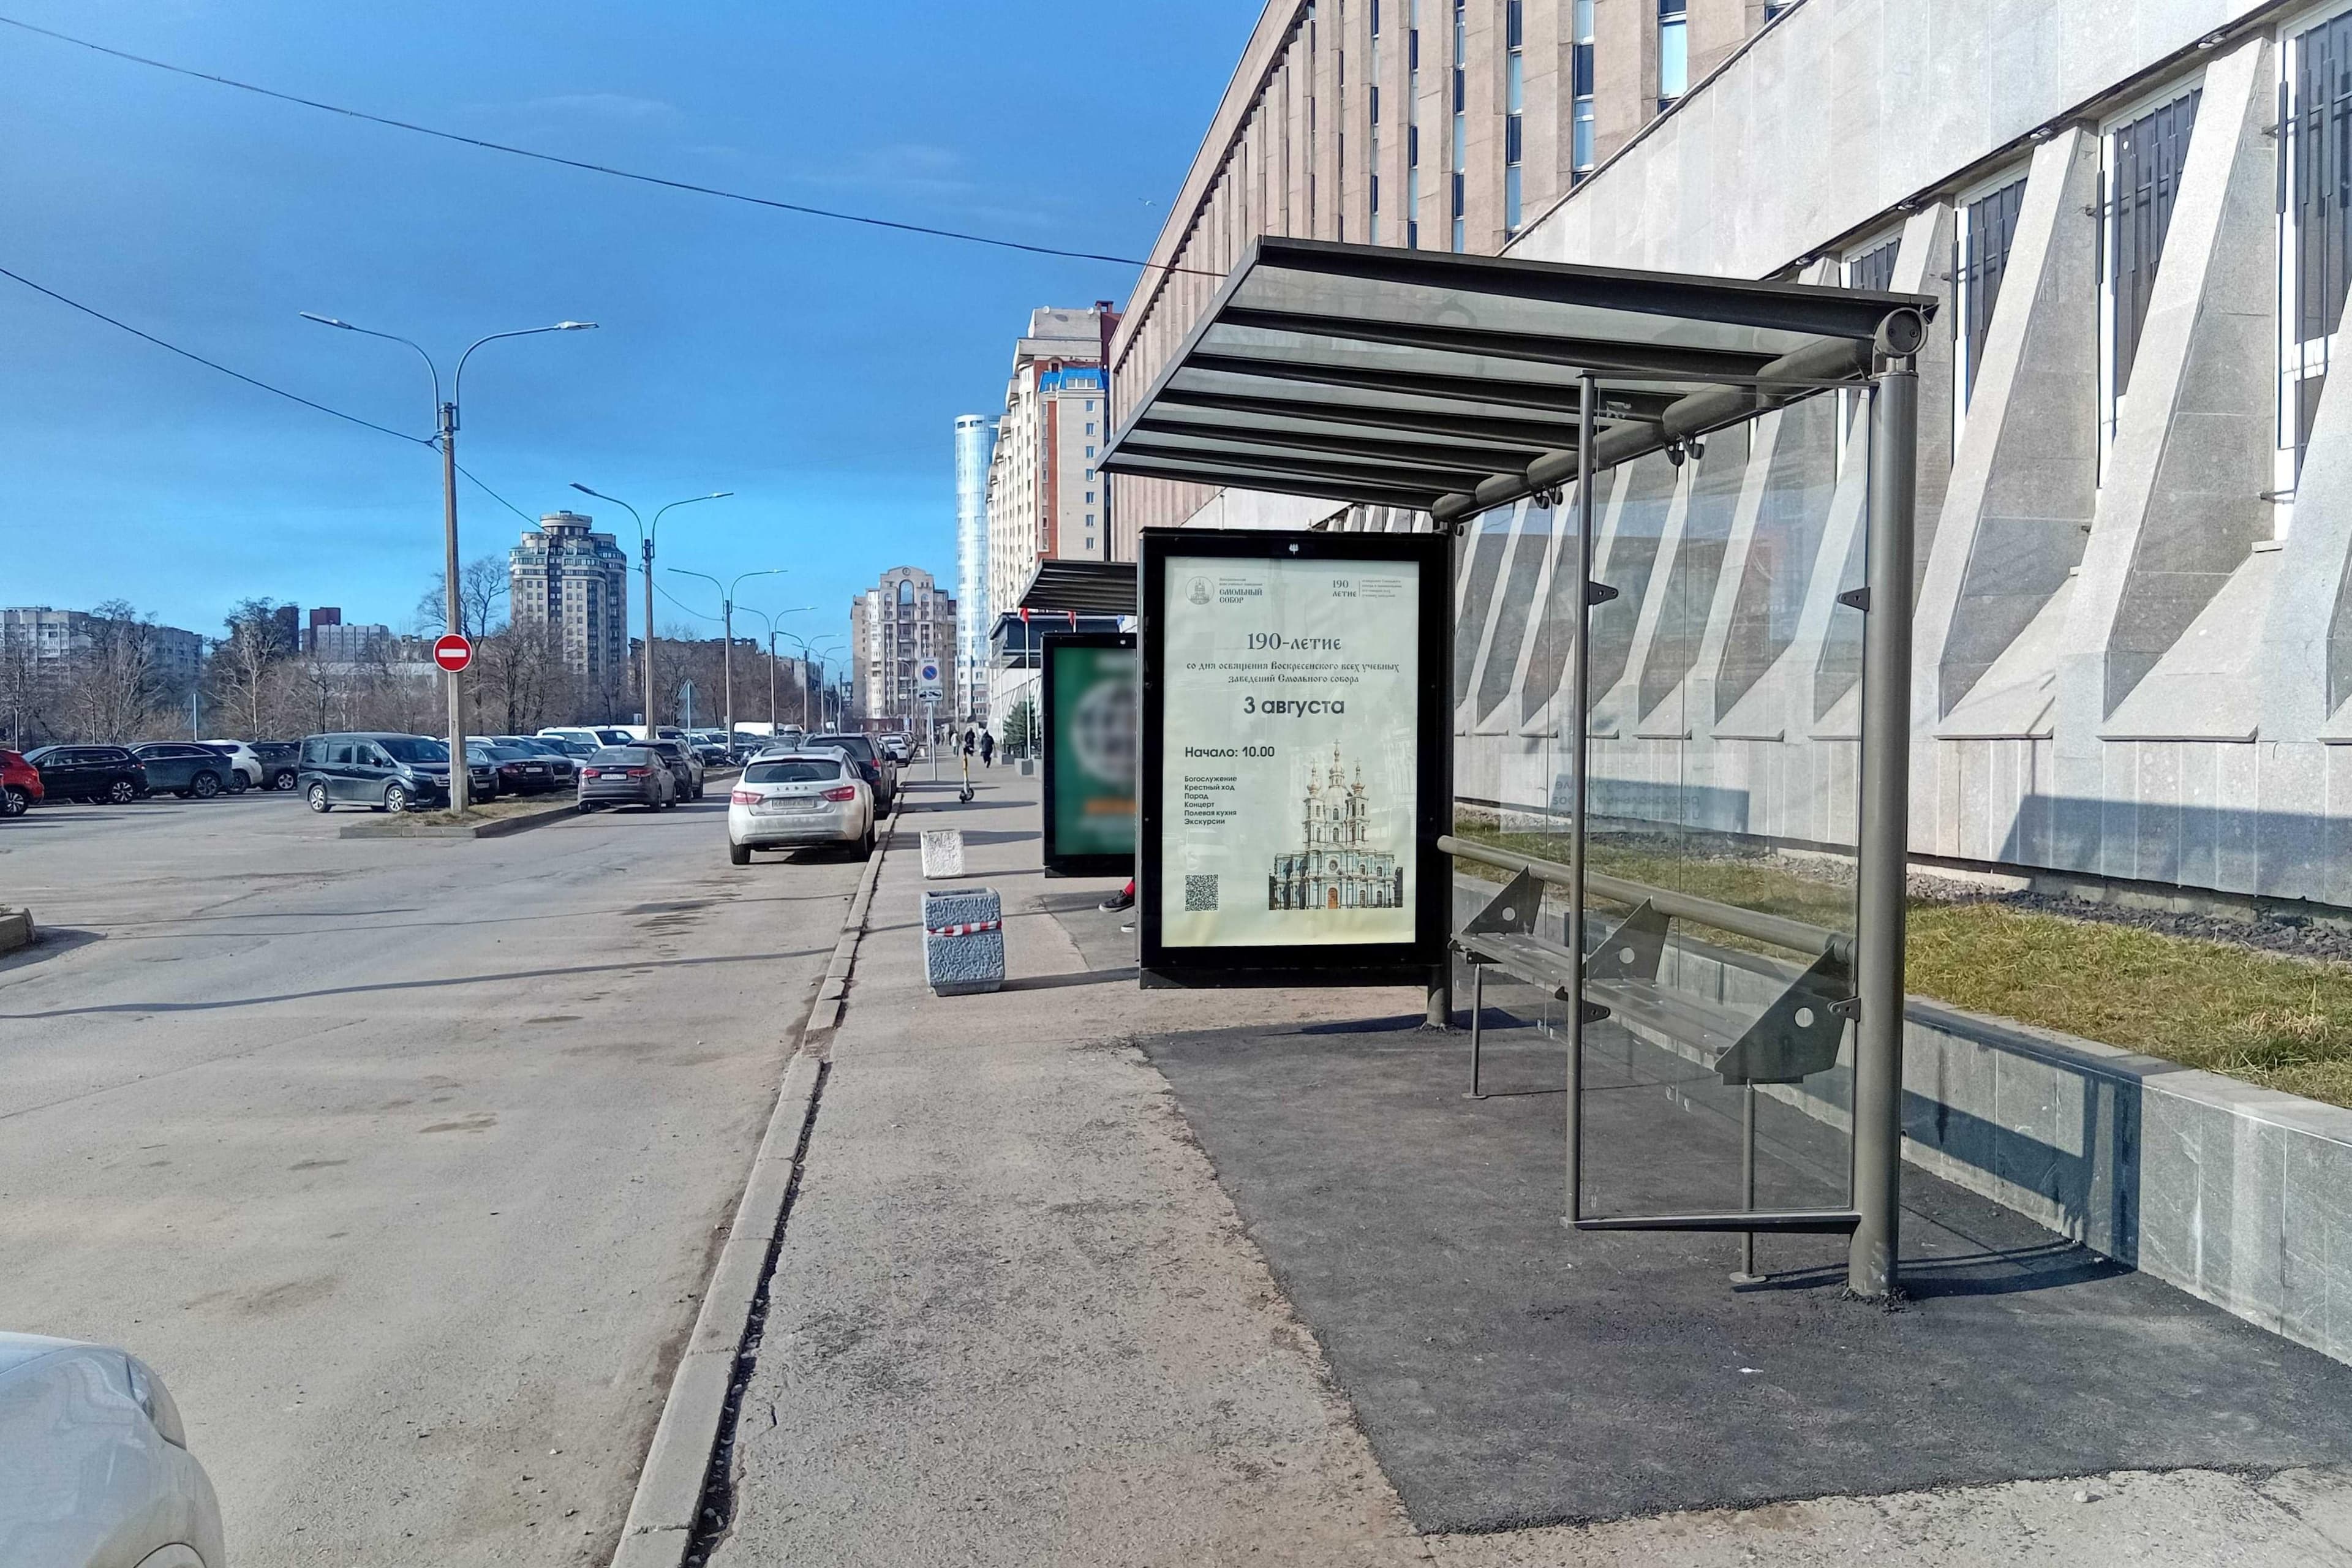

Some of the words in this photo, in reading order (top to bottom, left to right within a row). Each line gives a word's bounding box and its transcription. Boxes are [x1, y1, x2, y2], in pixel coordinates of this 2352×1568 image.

[1333, 579, 1349, 589] 190
[1218, 663, 1268, 671] освящения
[1271, 661, 1339, 672] Воскресенского
[1341, 663, 1360, 673] всех
[1362, 663, 1400, 673] учебных
[1227, 674, 1275, 684] заведений
[1278, 674, 1328, 683] Смольного
[1330, 676, 1359, 685] собора
[1243, 696, 1256, 714] 3
[1261, 699, 1344, 717] августа
[1185, 747, 1238, 758] Начало:
[1242, 746, 1275, 757] 10.00
